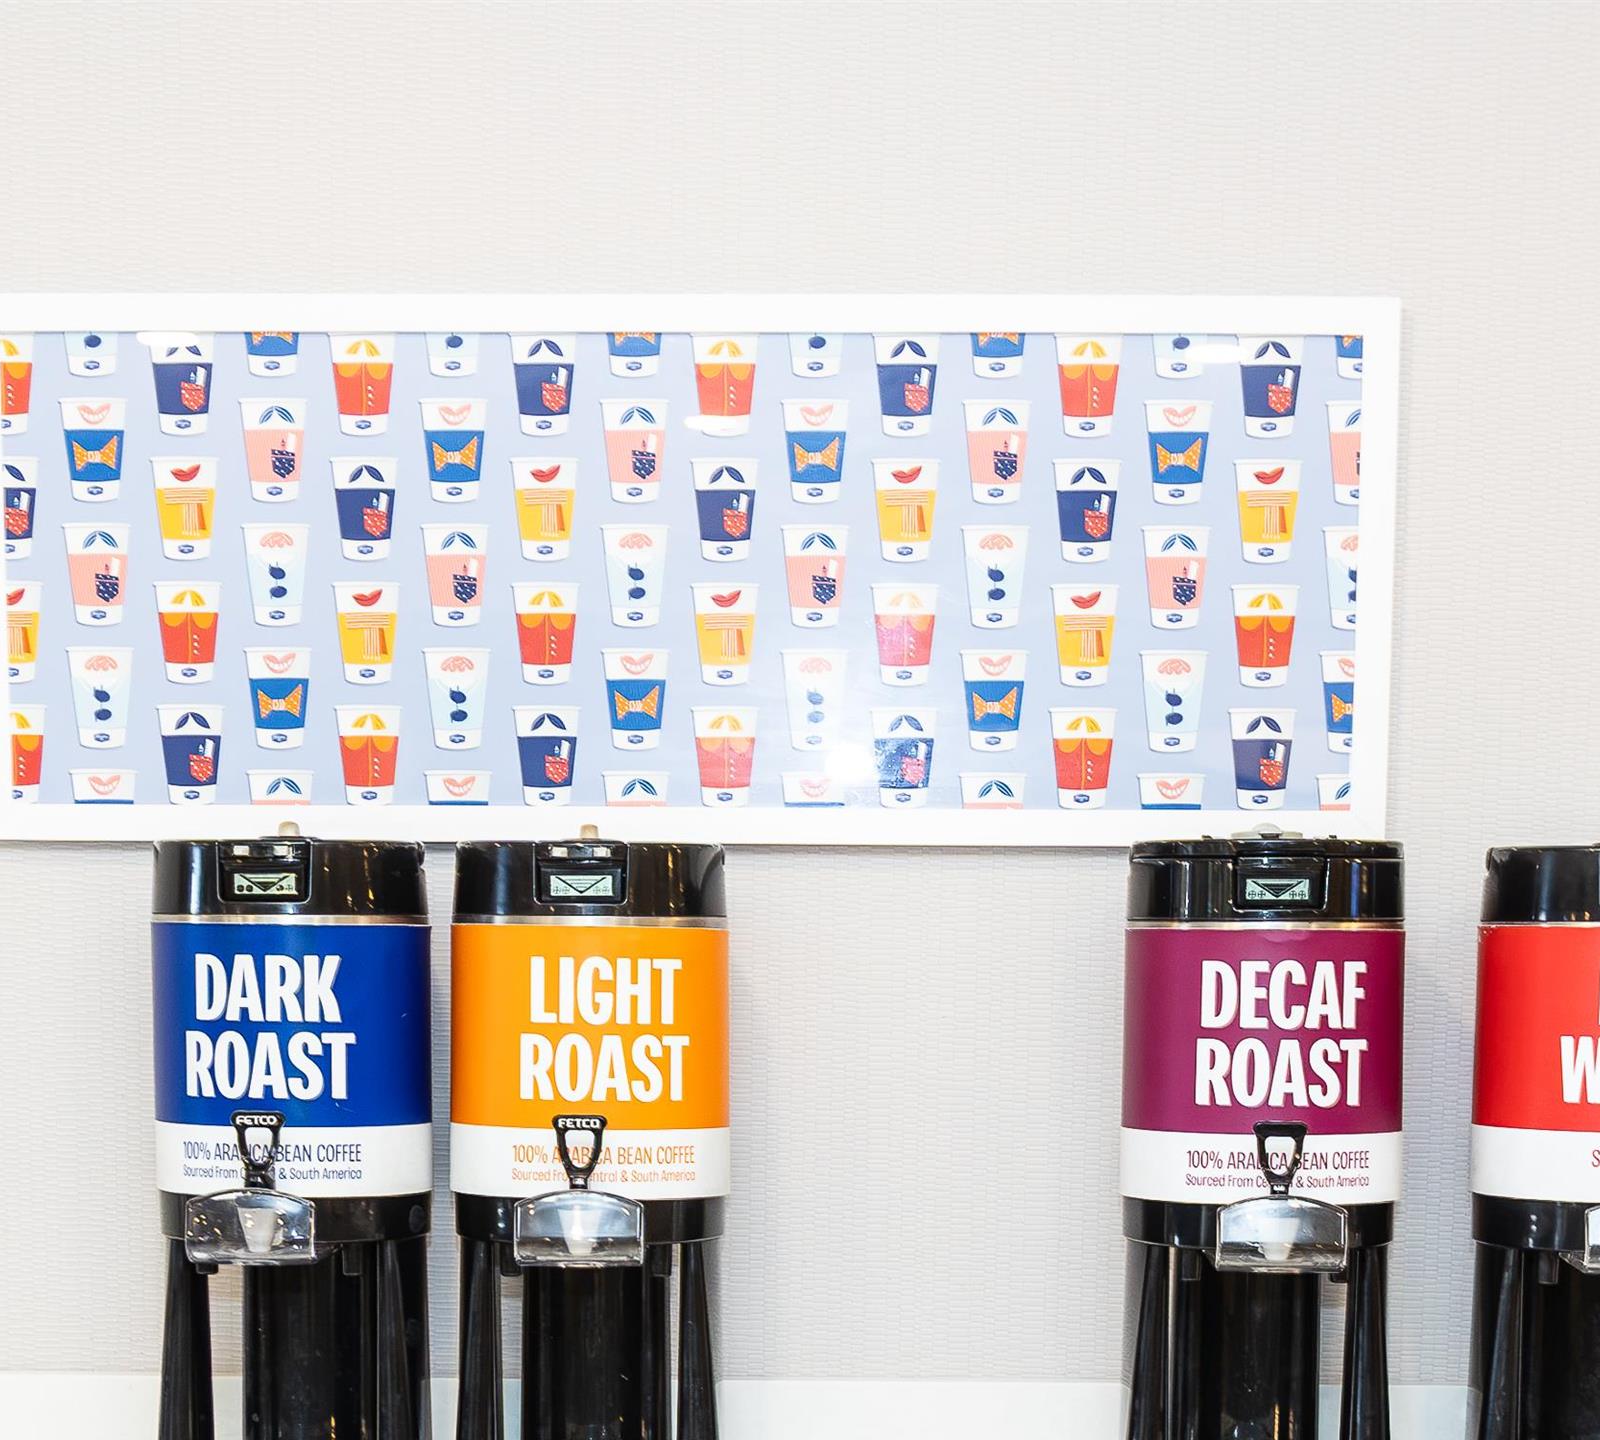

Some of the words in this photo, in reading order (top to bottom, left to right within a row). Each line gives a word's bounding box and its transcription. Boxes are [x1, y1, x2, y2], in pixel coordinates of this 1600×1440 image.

[194, 953, 343, 1024] DARK
[529, 955, 683, 1026] LIGHT
[1200, 959, 1368, 1031] DECAF
[185, 1029, 357, 1101] ROAST
[519, 1032, 691, 1103] ROAST
[1194, 1037, 1369, 1109] ROAST
[235, 1114, 279, 1126] FETCO
[557, 1117, 601, 1129] FETCO
[183, 1140, 211, 1160] 100%
[213, 1142, 273, 1162] ARAICA
[316, 1144, 362, 1163] COFFEE
[512, 1144, 548, 1164] 100%
[617, 1145, 653, 1165] BEAN
[656, 1145, 696, 1165] COFFEE
[1186, 1150, 1223, 1169] 100%
[1332, 1150, 1370, 1170] COFFEE
[183, 1164, 214, 1178] Sourced
[215, 1166, 239, 1180] From
[289, 1167, 320, 1180] South
[322, 1167, 362, 1180] America
[512, 1168, 551, 1182] Sourced
[631, 1169, 659, 1183] South
[661, 1169, 696, 1182] America
[1185, 1173, 1225, 1187] Sourced
[1227, 1174, 1254, 1188] From
[1306, 1175, 1335, 1188] South
[1336, 1175, 1370, 1187] America
